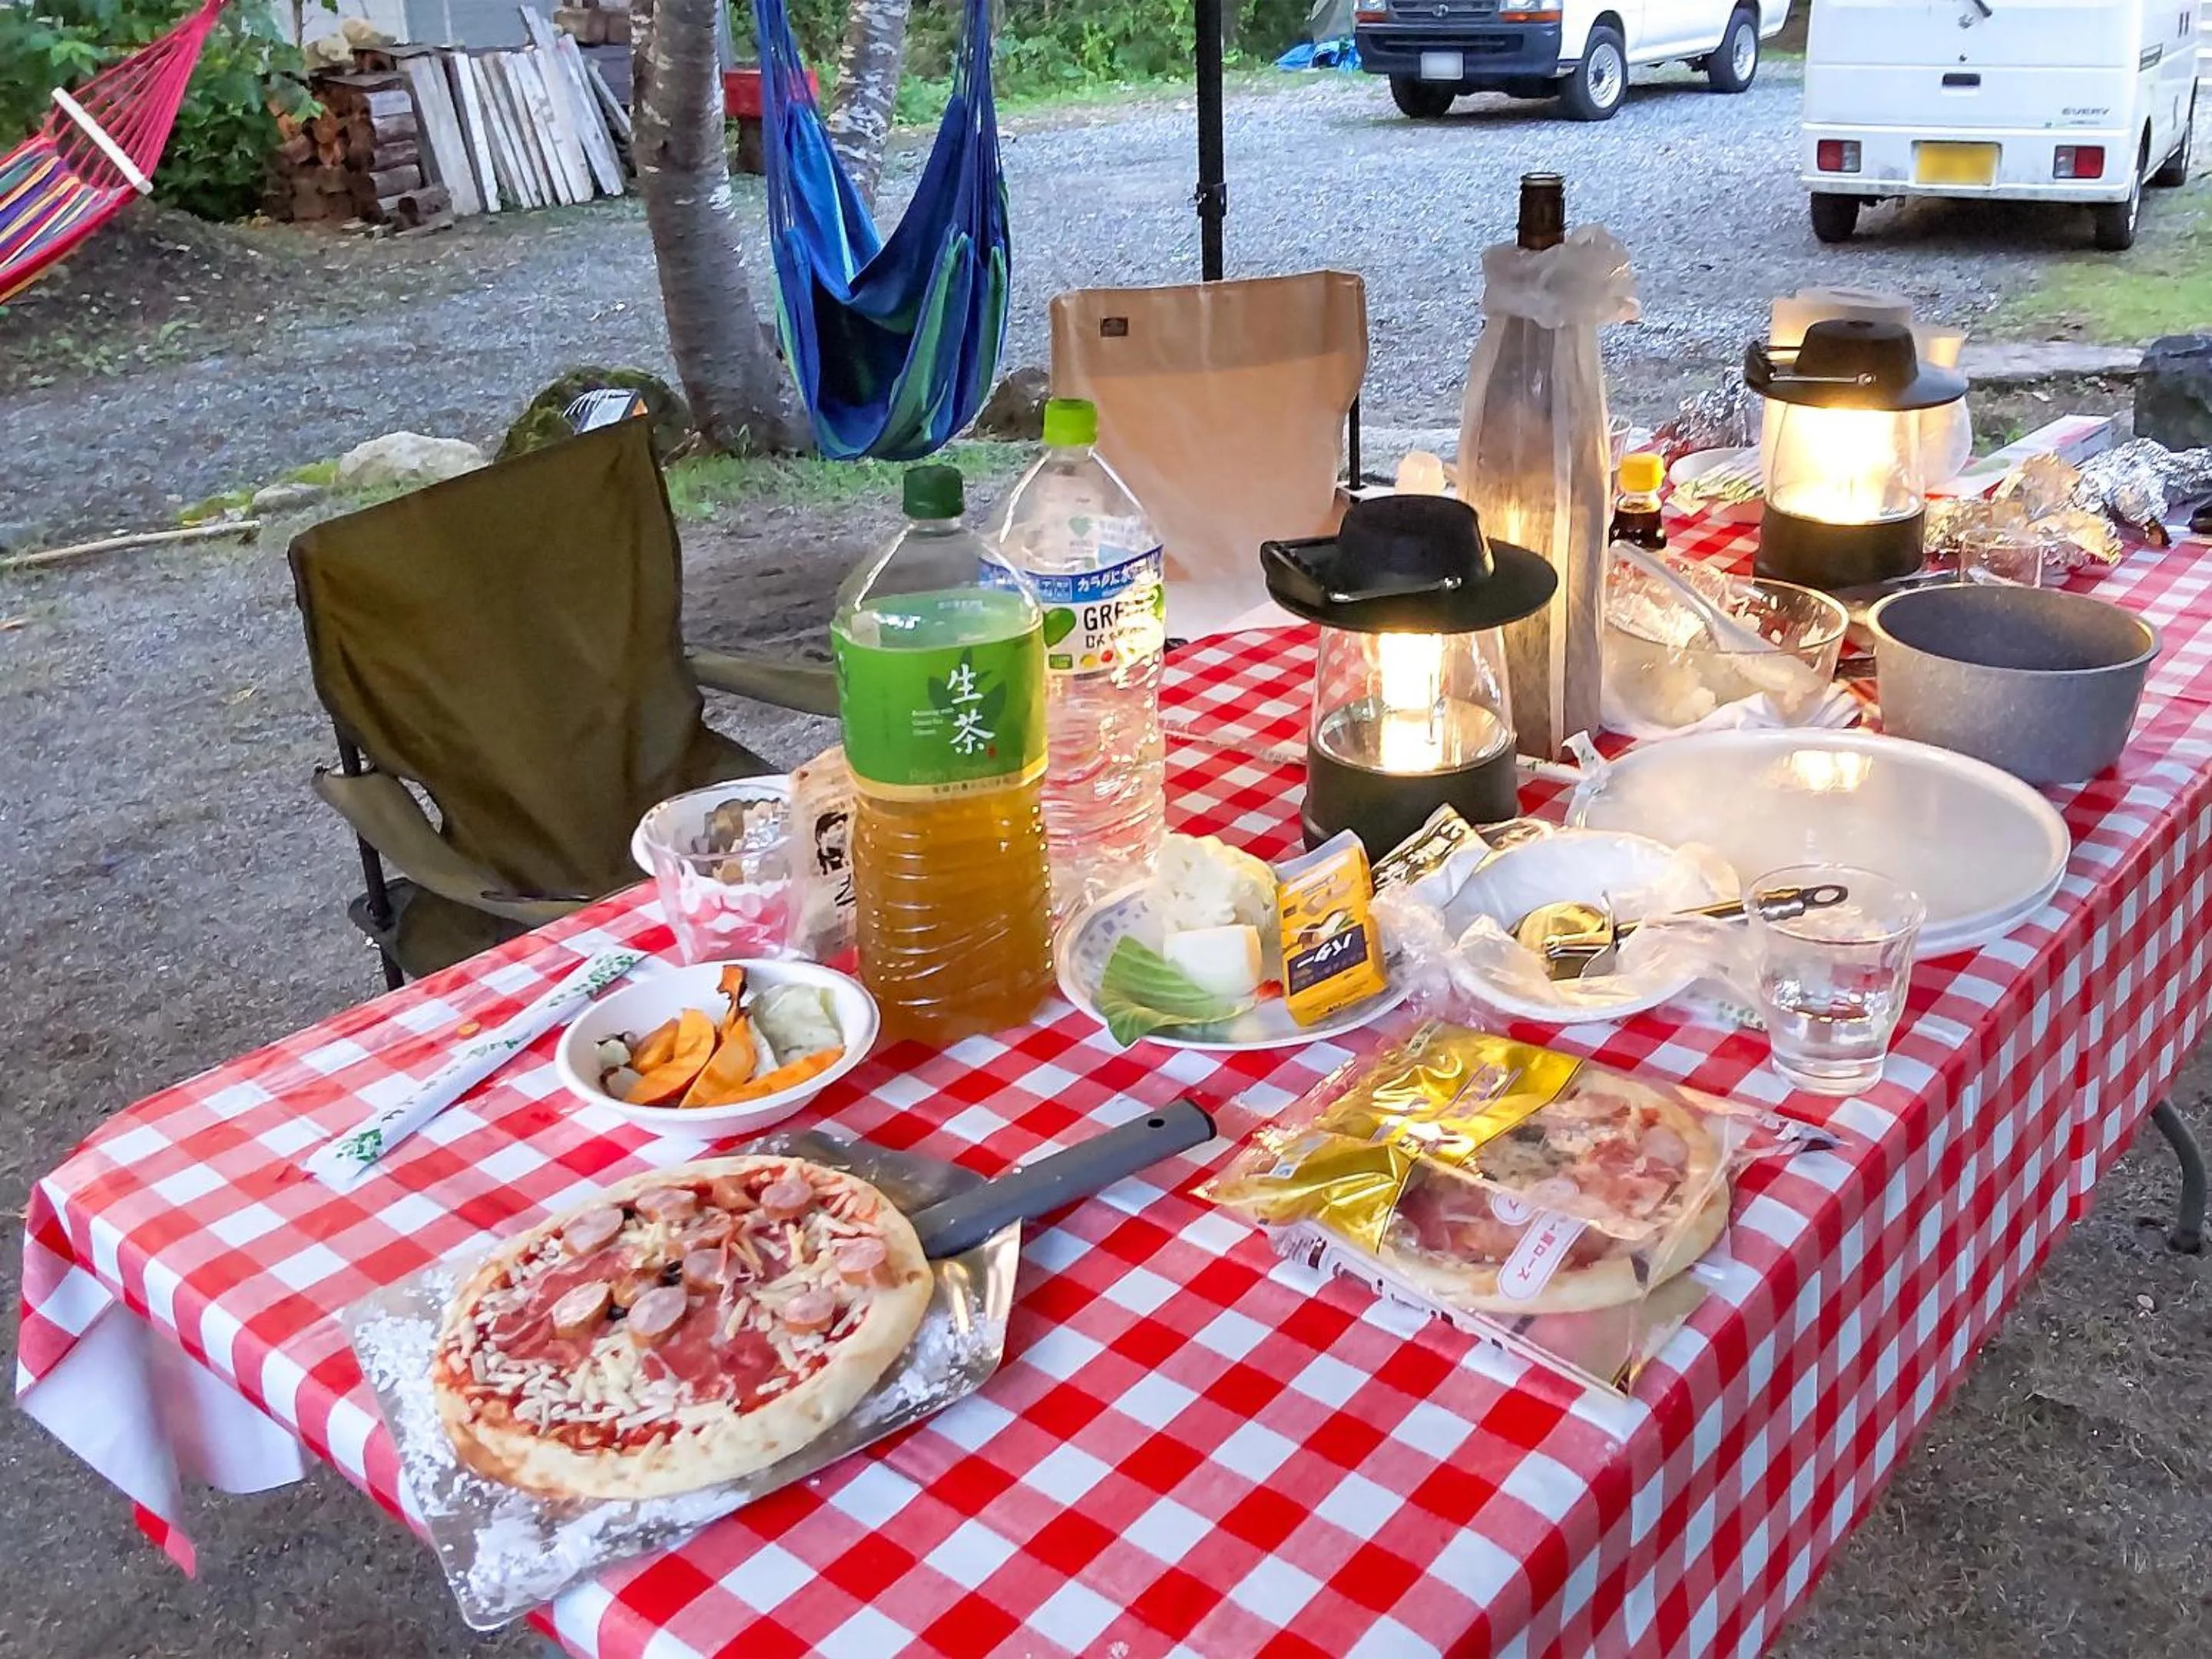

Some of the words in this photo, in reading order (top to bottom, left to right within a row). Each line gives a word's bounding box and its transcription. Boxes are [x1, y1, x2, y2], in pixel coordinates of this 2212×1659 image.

[946, 664, 995, 754] 生茶
[1297, 933, 1353, 968] バター
